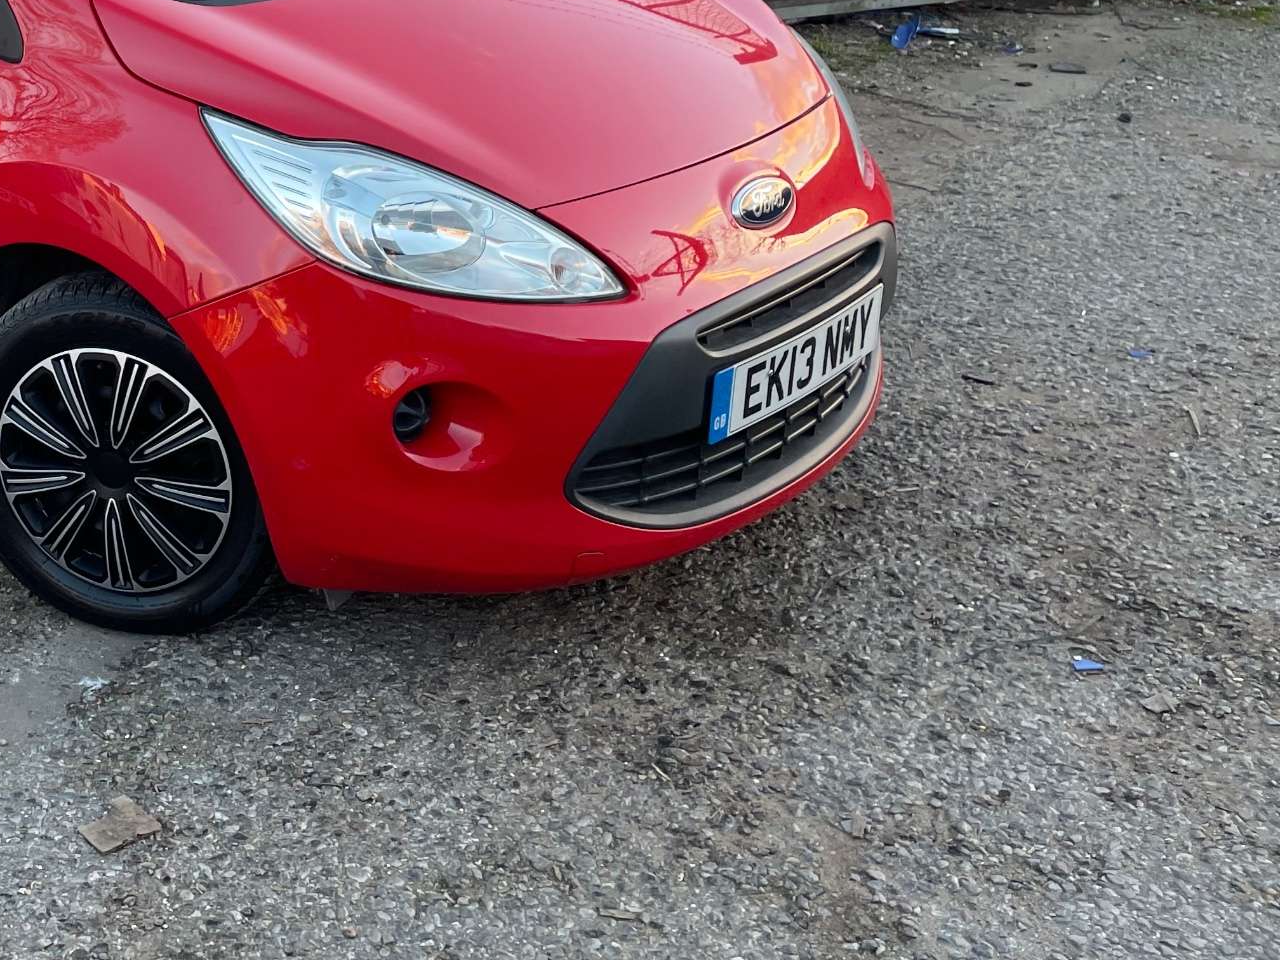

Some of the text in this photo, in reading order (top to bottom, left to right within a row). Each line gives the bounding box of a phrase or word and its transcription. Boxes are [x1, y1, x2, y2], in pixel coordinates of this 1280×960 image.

[752, 185, 785, 218] Ford
[742, 298, 875, 420] EK13 NMY
[713, 411, 727, 432] GB
